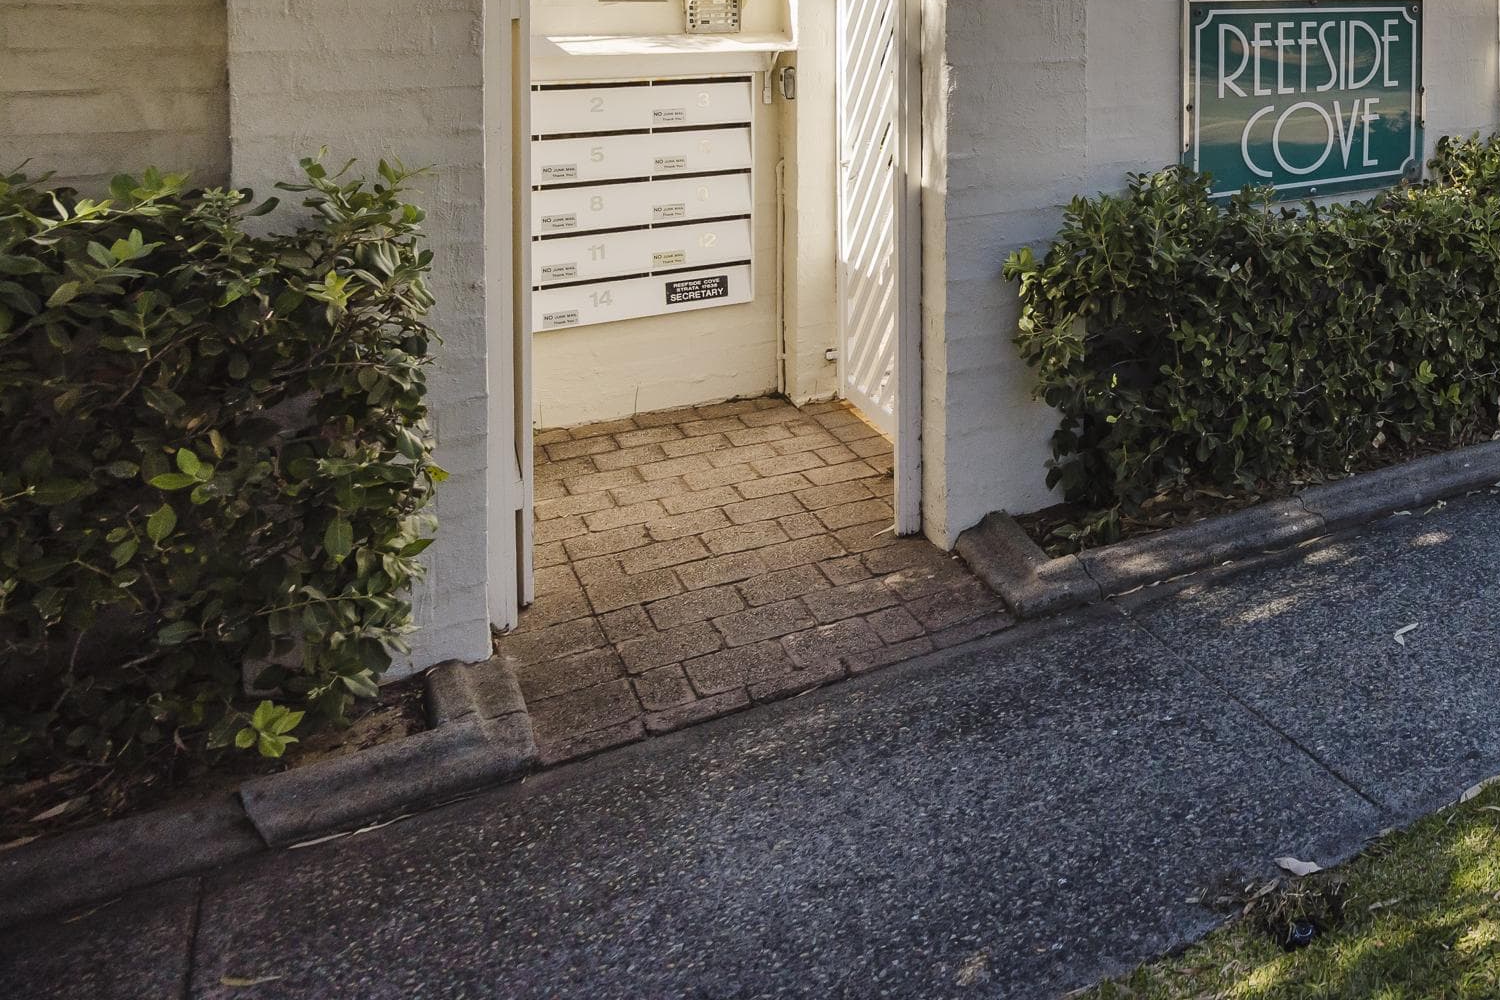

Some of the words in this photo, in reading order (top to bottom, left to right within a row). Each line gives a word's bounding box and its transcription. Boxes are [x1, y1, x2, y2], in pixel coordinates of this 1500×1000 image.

[1218, 19, 1400, 98] REEFSIDE
[590, 97, 604, 112] 2
[697, 91, 710, 107] 3
[1241, 97, 1380, 178] COVE
[590, 147, 604, 163] 5
[590, 196, 604, 212] 8
[698, 233, 717, 249] 12
[588, 244, 605, 261] 11
[673, 280, 701, 289] REEFSIDE
[676, 285, 700, 293] STRATA
[589, 290, 613, 308] 14
[670, 287, 724, 302] SECRETARY
